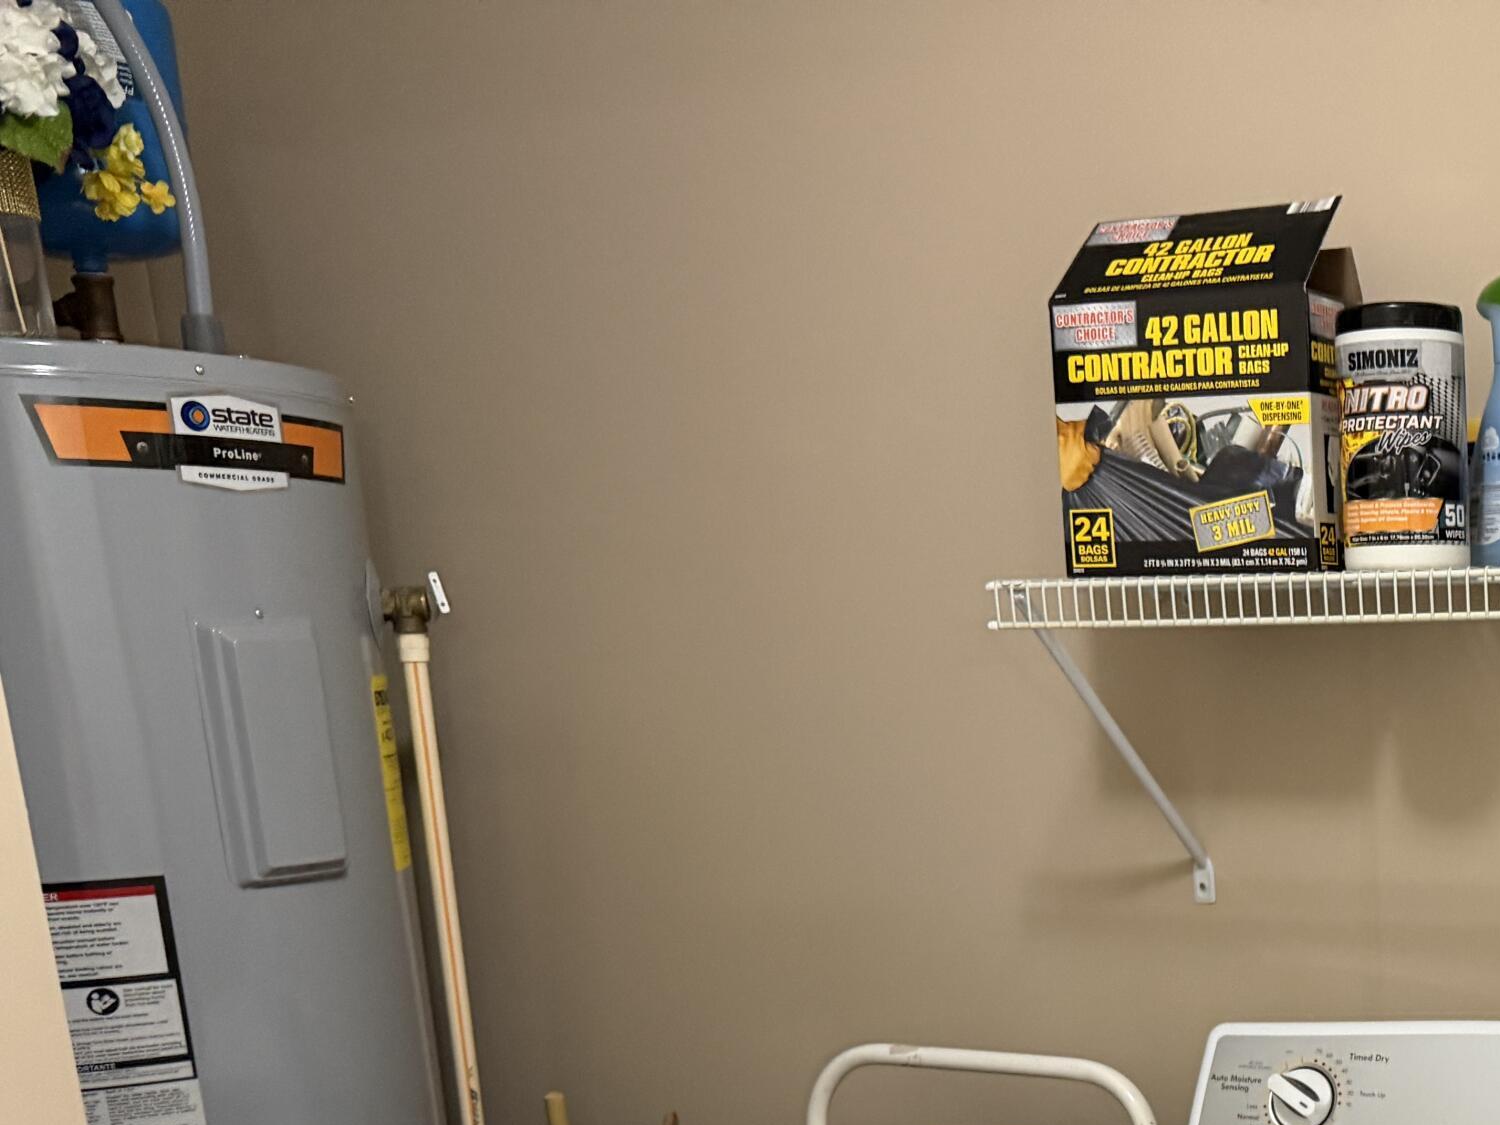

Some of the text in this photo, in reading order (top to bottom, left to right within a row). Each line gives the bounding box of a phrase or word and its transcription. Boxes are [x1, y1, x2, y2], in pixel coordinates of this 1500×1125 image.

[1143, 233, 1253, 257] 42 GALLON
[1105, 244, 1275, 277] CONTRACTOR
[1141, 267, 1223, 283] CLEAN-UP BAGS
[1055, 310, 1134, 328] CONTRACTOR'S
[1076, 327, 1116, 343] CHOICE
[1145, 309, 1278, 346] 42 GALLON
[1238, 343, 1289, 359] CLEAN-UP
[1067, 347, 1233, 383] CONTRACTOR
[1239, 359, 1270, 374] BAGS
[1348, 348, 1419, 371] SIMONIZ
[1170, 383, 1197, 392] GALONES
[1198, 382, 1215, 390] PARA
[1215, 379, 1260, 390] CONTRATISTAS
[1345, 384, 1429, 414] NITRO
[211, 407, 274, 429] state
[1262, 411, 1302, 422] DISPENSING
[1343, 415, 1444, 432] PROTECTANT
[213, 424, 242, 434] WATER
[1377, 429, 1433, 454] Wipes
[212, 446, 259, 461] ProLine
[198, 472, 249, 482] COMMERCIAL
[1200, 501, 1261, 525] HEAVY DUTY
[1444, 503, 1465, 527] 50
[1074, 517, 1111, 543] 24
[1212, 518, 1256, 541] 3 MIL
[1321, 528, 1336, 547] 24
[1445, 530, 1466, 540] WIPES
[1078, 544, 1109, 556] BAGS
[1250, 549, 1267, 557] BAGS
[1275, 548, 1288, 557] GAL
[1080, 555, 1108, 564] BOLSAS
[1350, 1053, 1390, 1064] Timed Dry
[1211, 1074, 1262, 1084] Auto Moisture
[1220, 1083, 1250, 1093] Sensing
